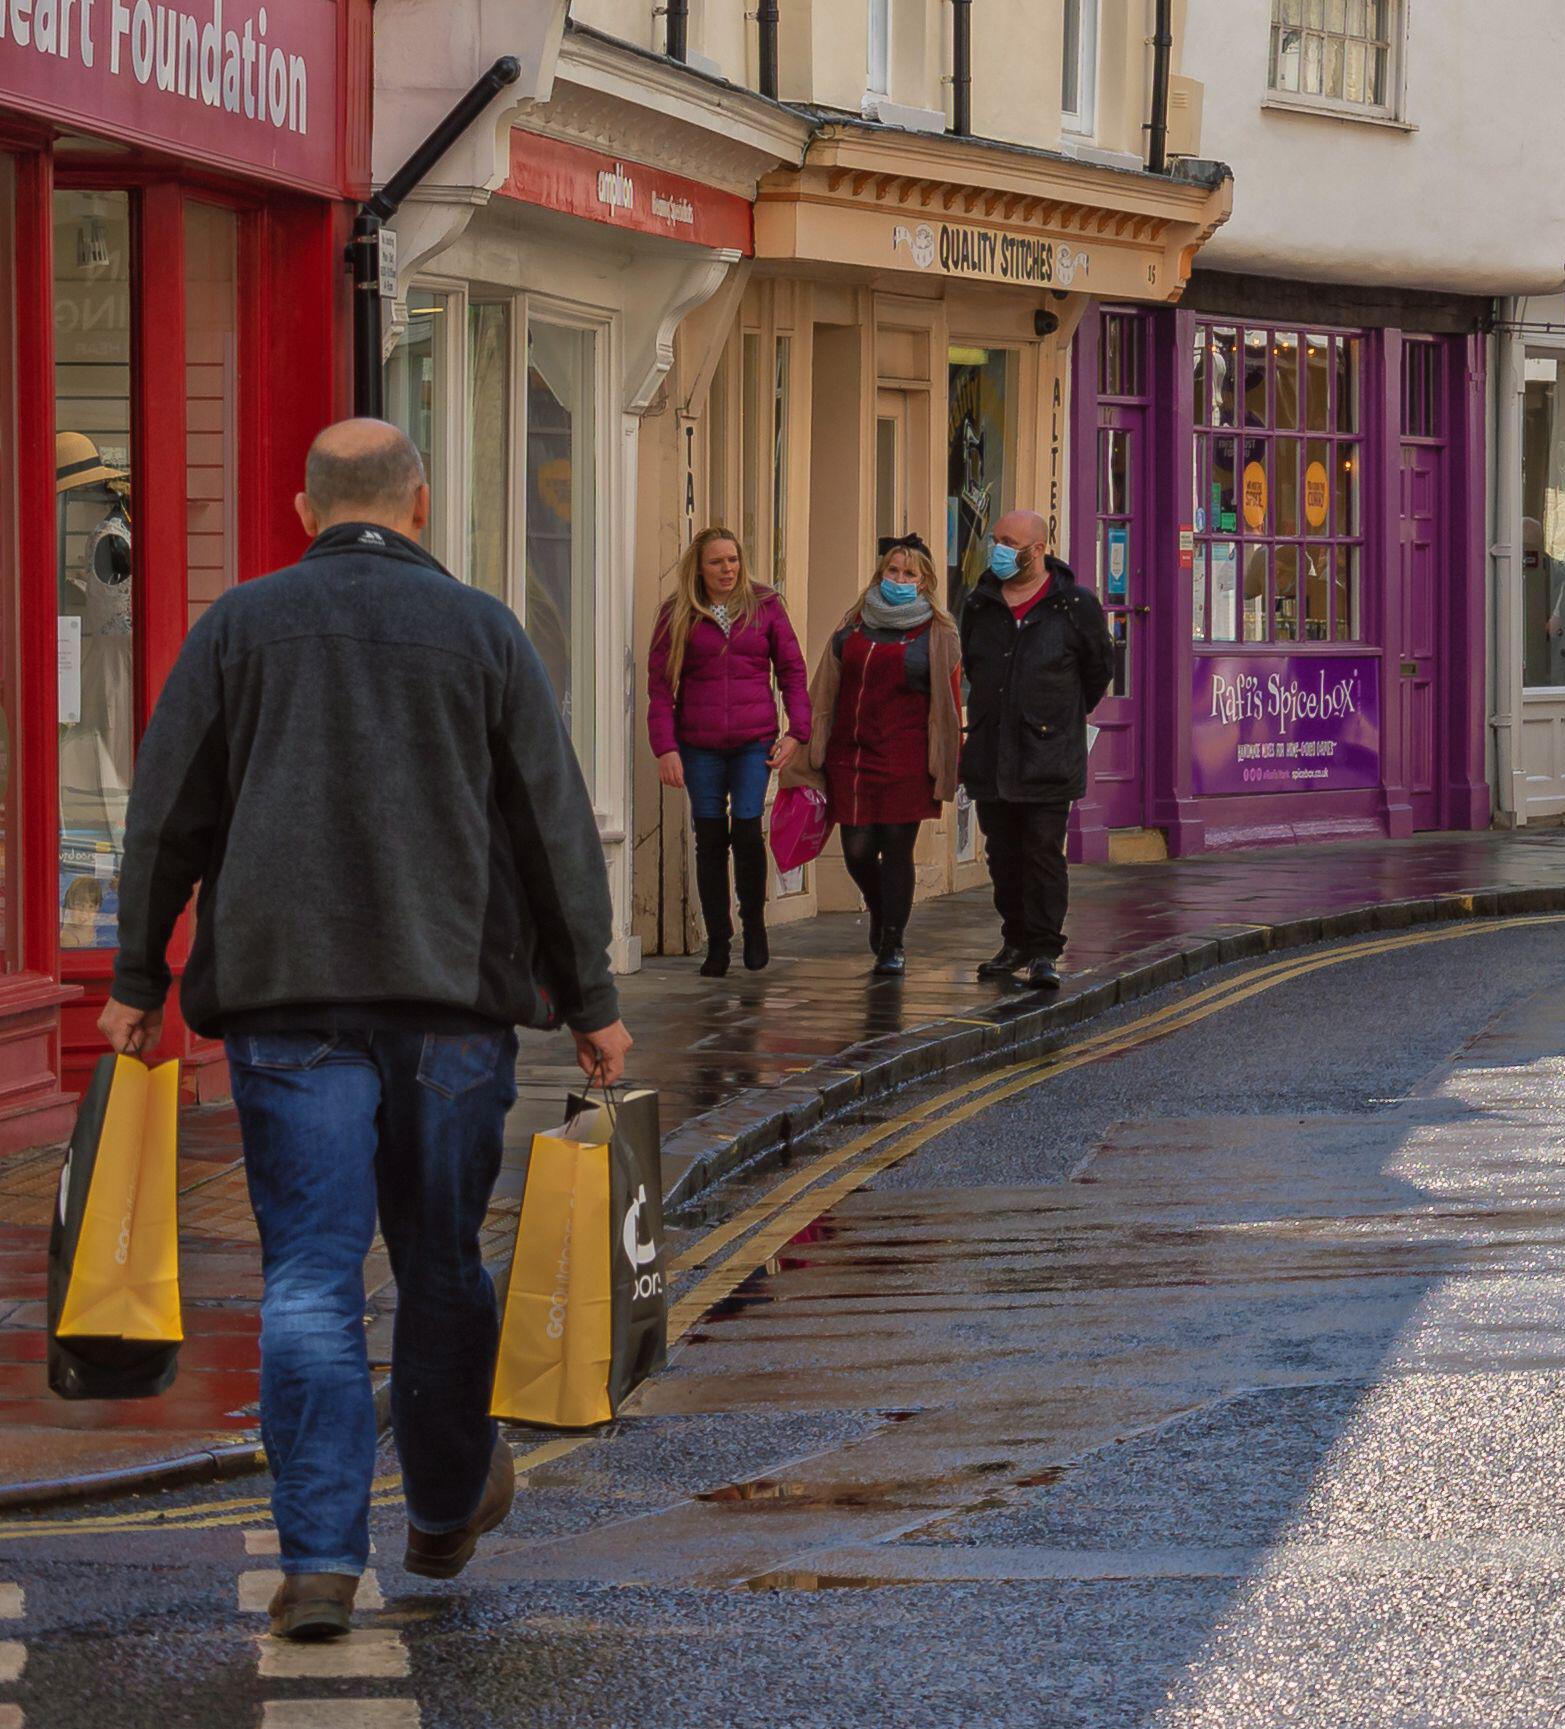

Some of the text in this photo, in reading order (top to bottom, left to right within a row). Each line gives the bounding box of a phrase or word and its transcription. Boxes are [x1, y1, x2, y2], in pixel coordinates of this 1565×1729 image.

[939, 223, 1054, 284] QUALITY STITCHES
[1147, 264, 1156, 285] 15
[1210, 673, 1263, 726] Rafi's
